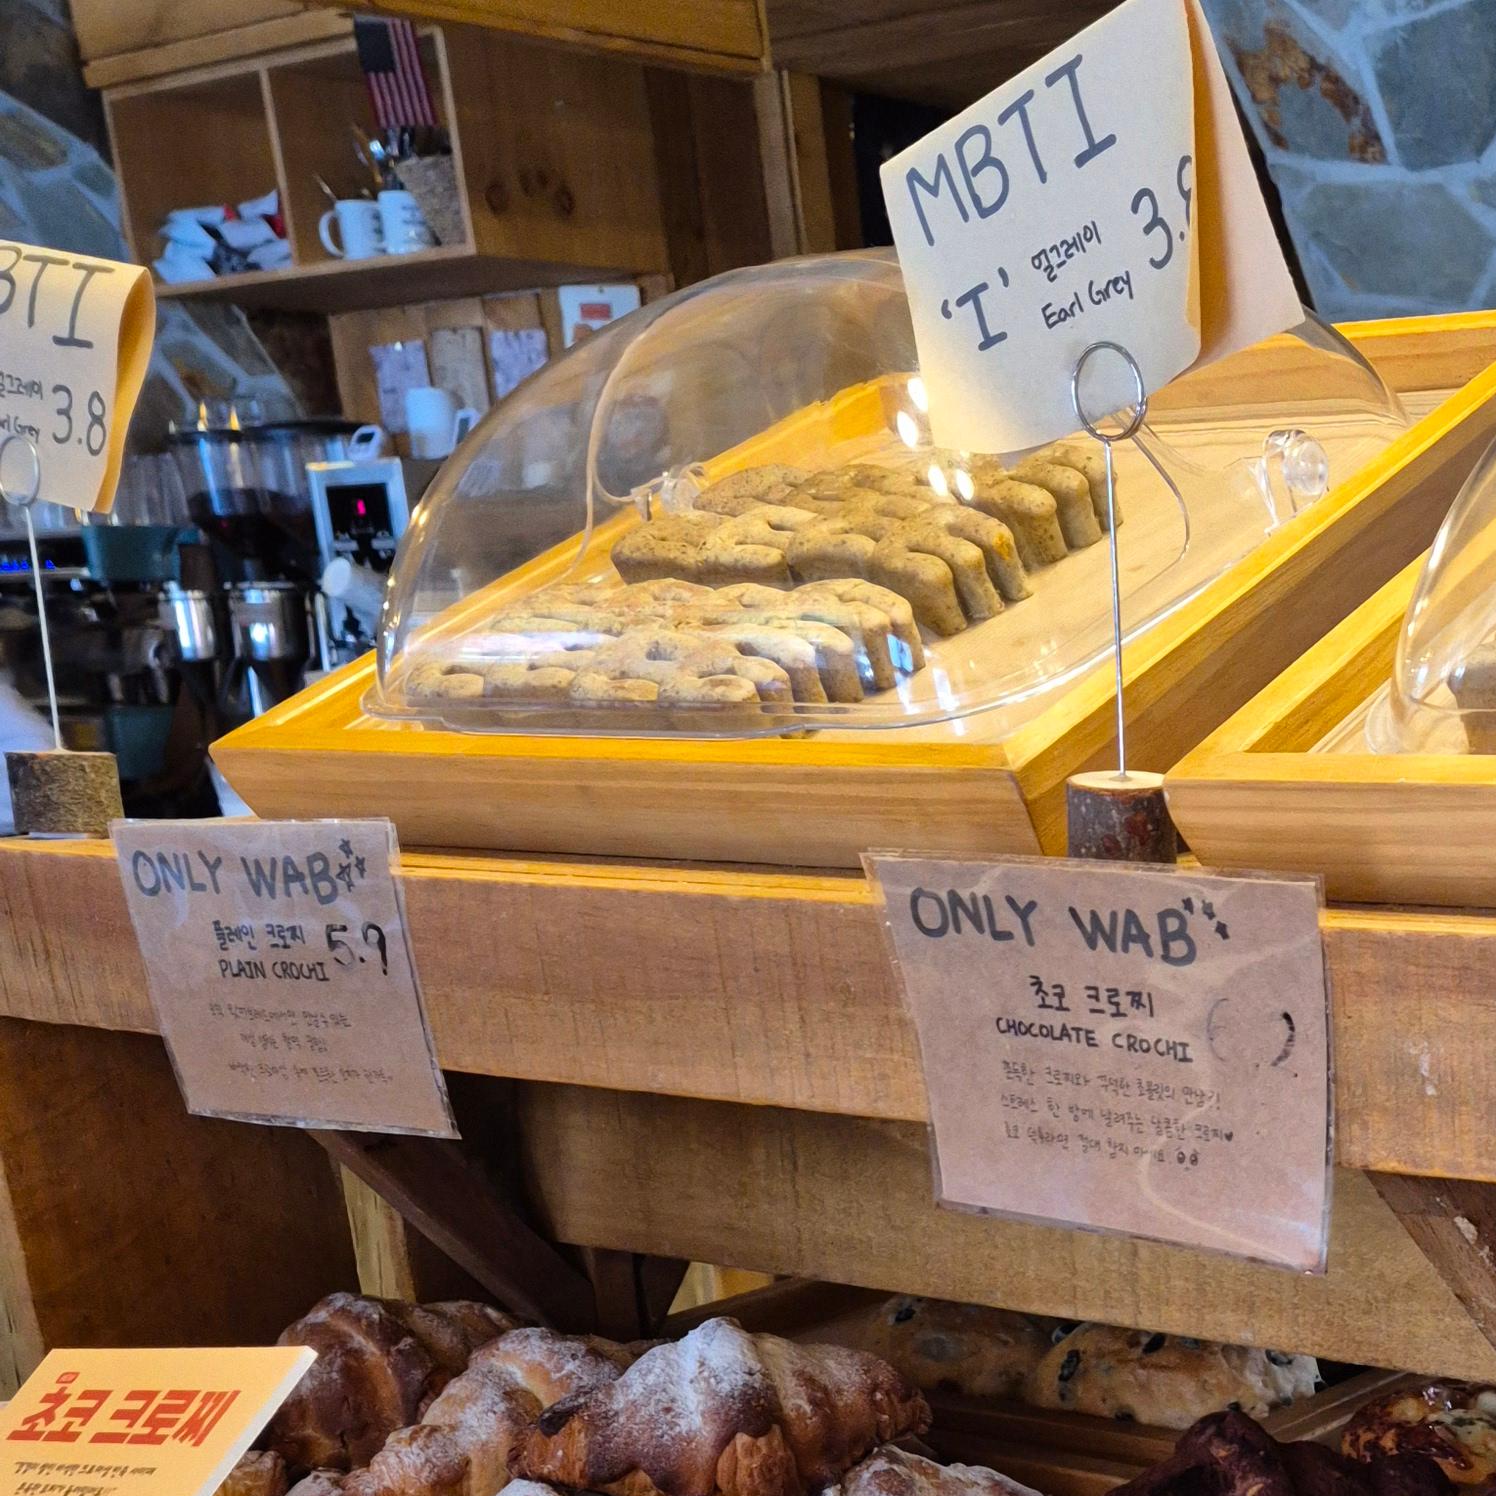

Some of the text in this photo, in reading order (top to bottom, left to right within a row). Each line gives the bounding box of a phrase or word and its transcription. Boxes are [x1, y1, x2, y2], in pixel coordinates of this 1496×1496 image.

[906, 54, 1117, 246] MBTI
[1031, 221, 1102, 283] 얼그레이
[1041, 270, 1134, 329] Earl Grey
[52, 384, 106, 456] 3.8
[132, 850, 338, 906] ONLY WAB
[911, 887, 1197, 966] ONLY WAB
[219, 959, 330, 984] PLAIN CROCHI
[1029, 975, 1155, 1018] 초코 크로찌
[995, 1016, 1194, 1063] CHOCOLATE CROCHI
[6, 1386, 241, 1447] 초코 크로찌
